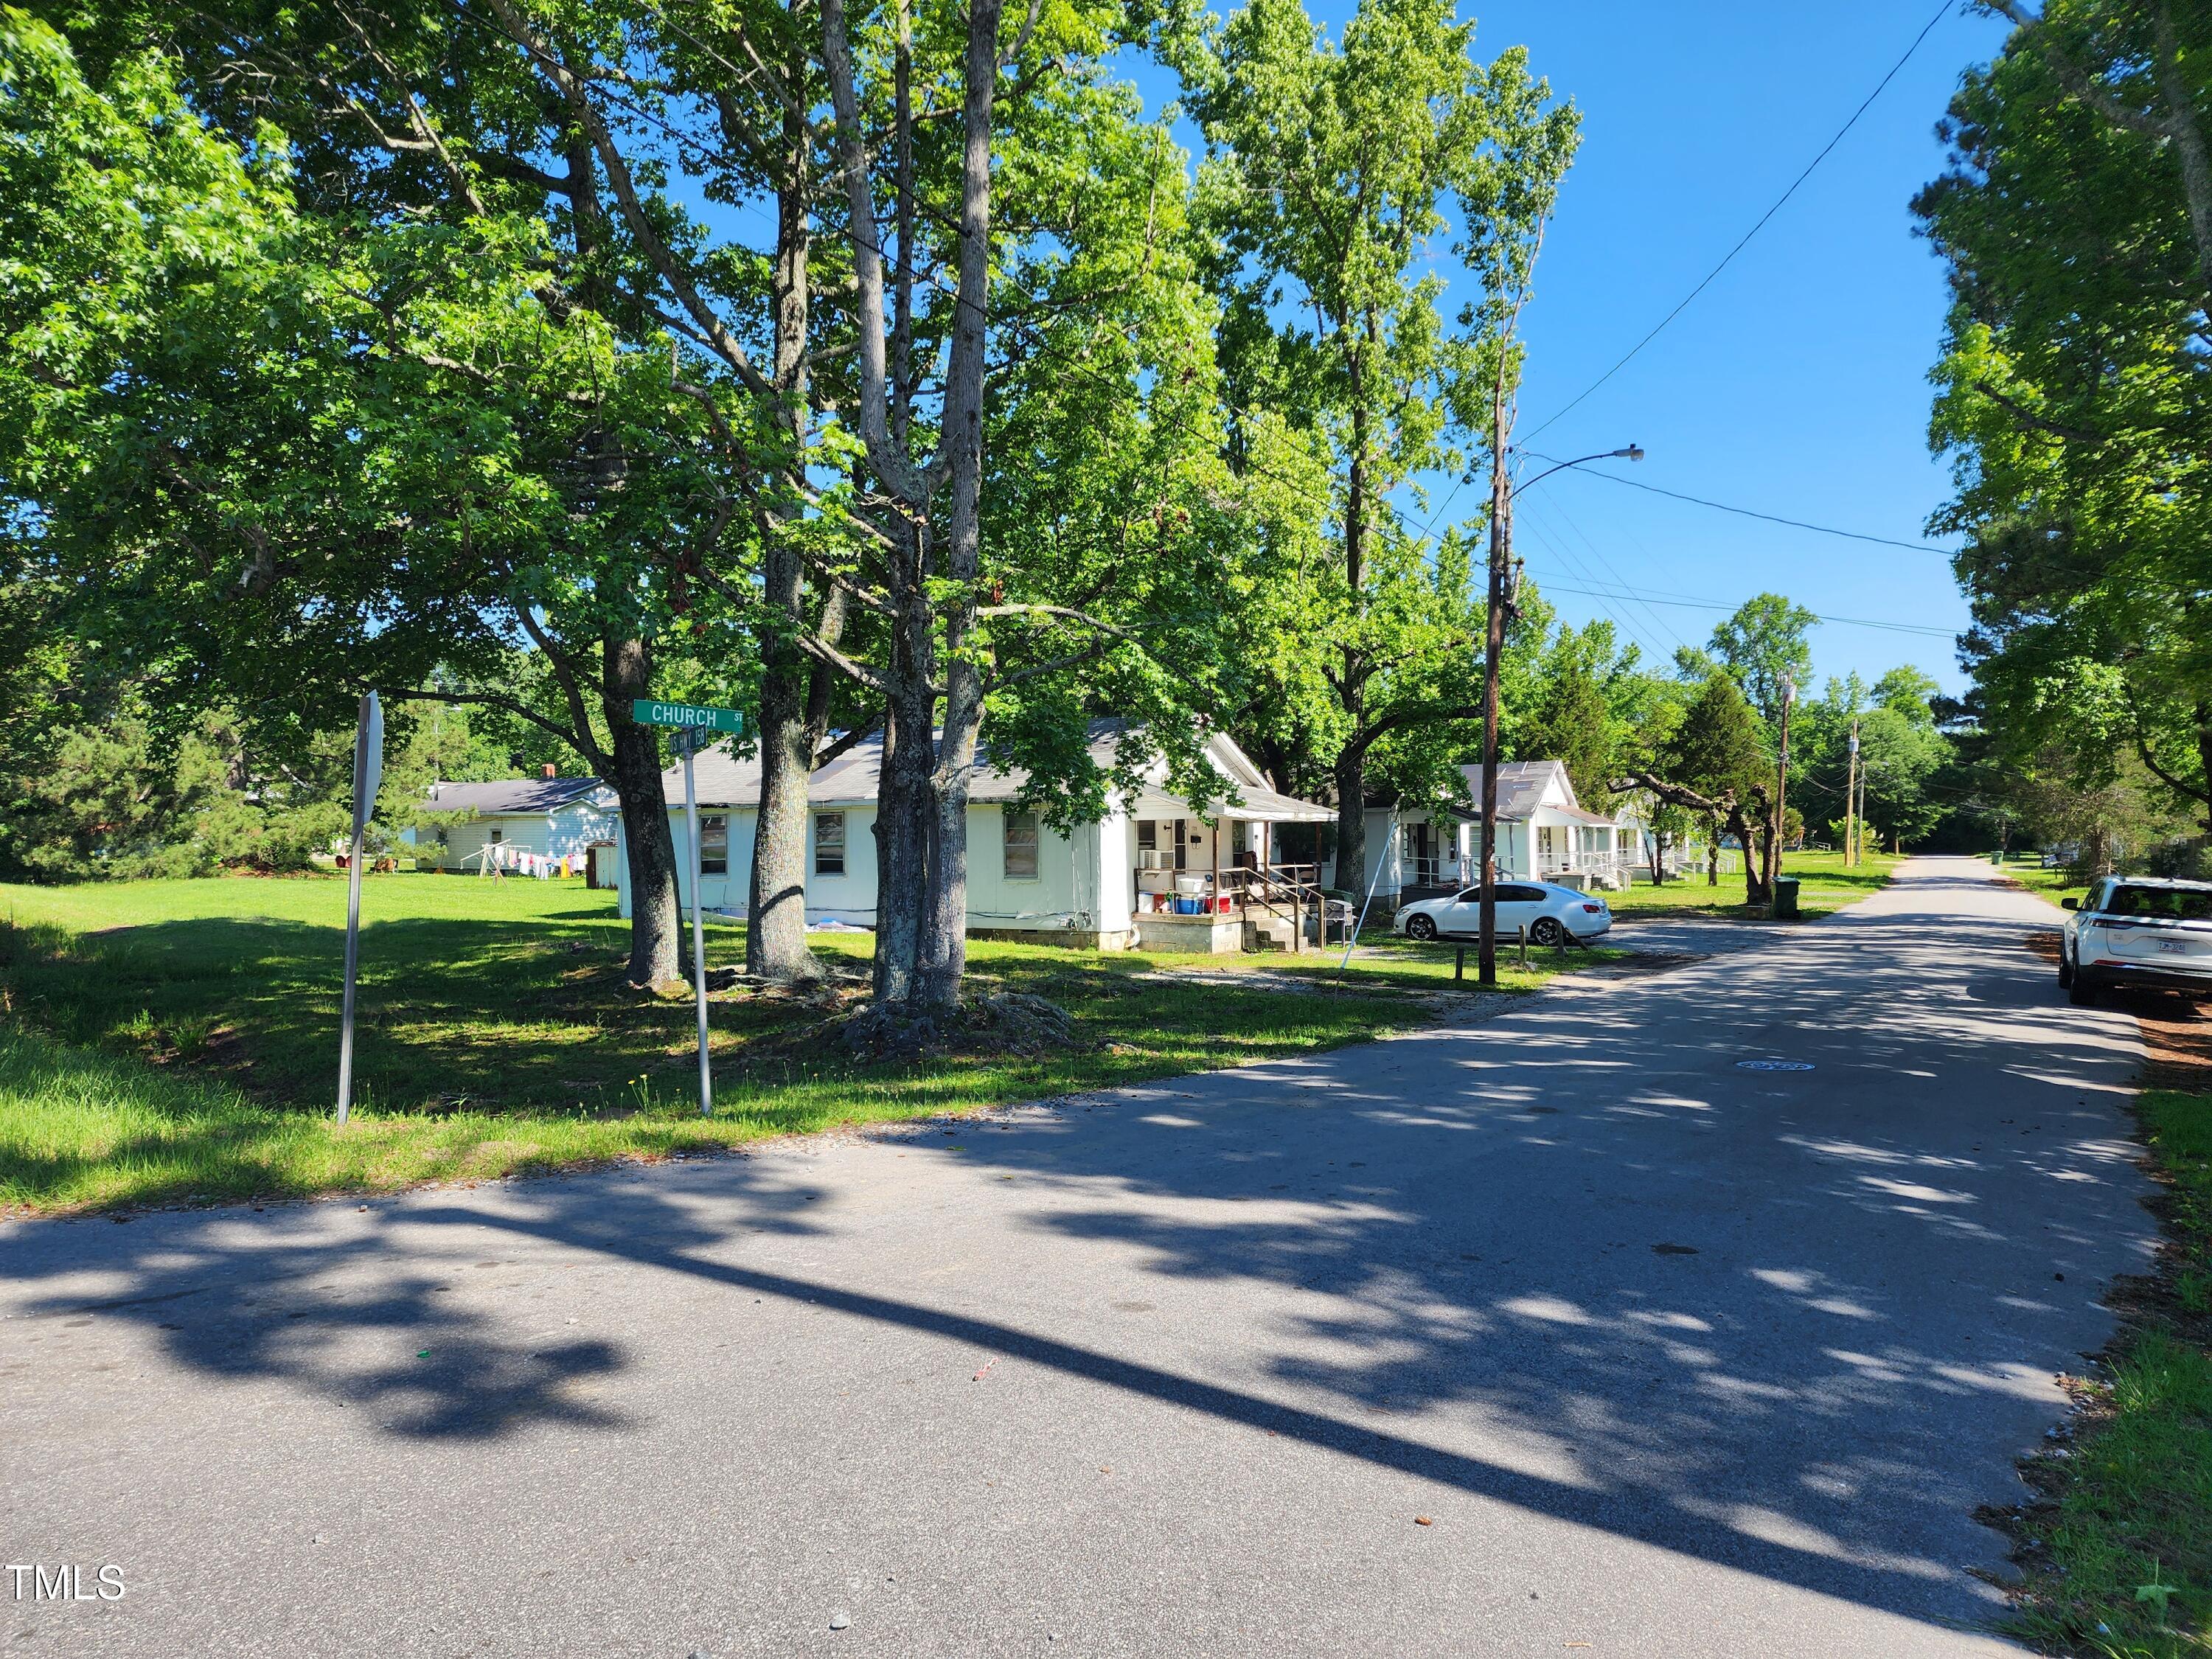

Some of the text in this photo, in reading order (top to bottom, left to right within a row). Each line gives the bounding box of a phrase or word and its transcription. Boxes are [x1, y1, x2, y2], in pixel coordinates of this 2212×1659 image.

[653, 705, 743, 726] CHURCH ST
[669, 727, 705, 753] US HWY 158
